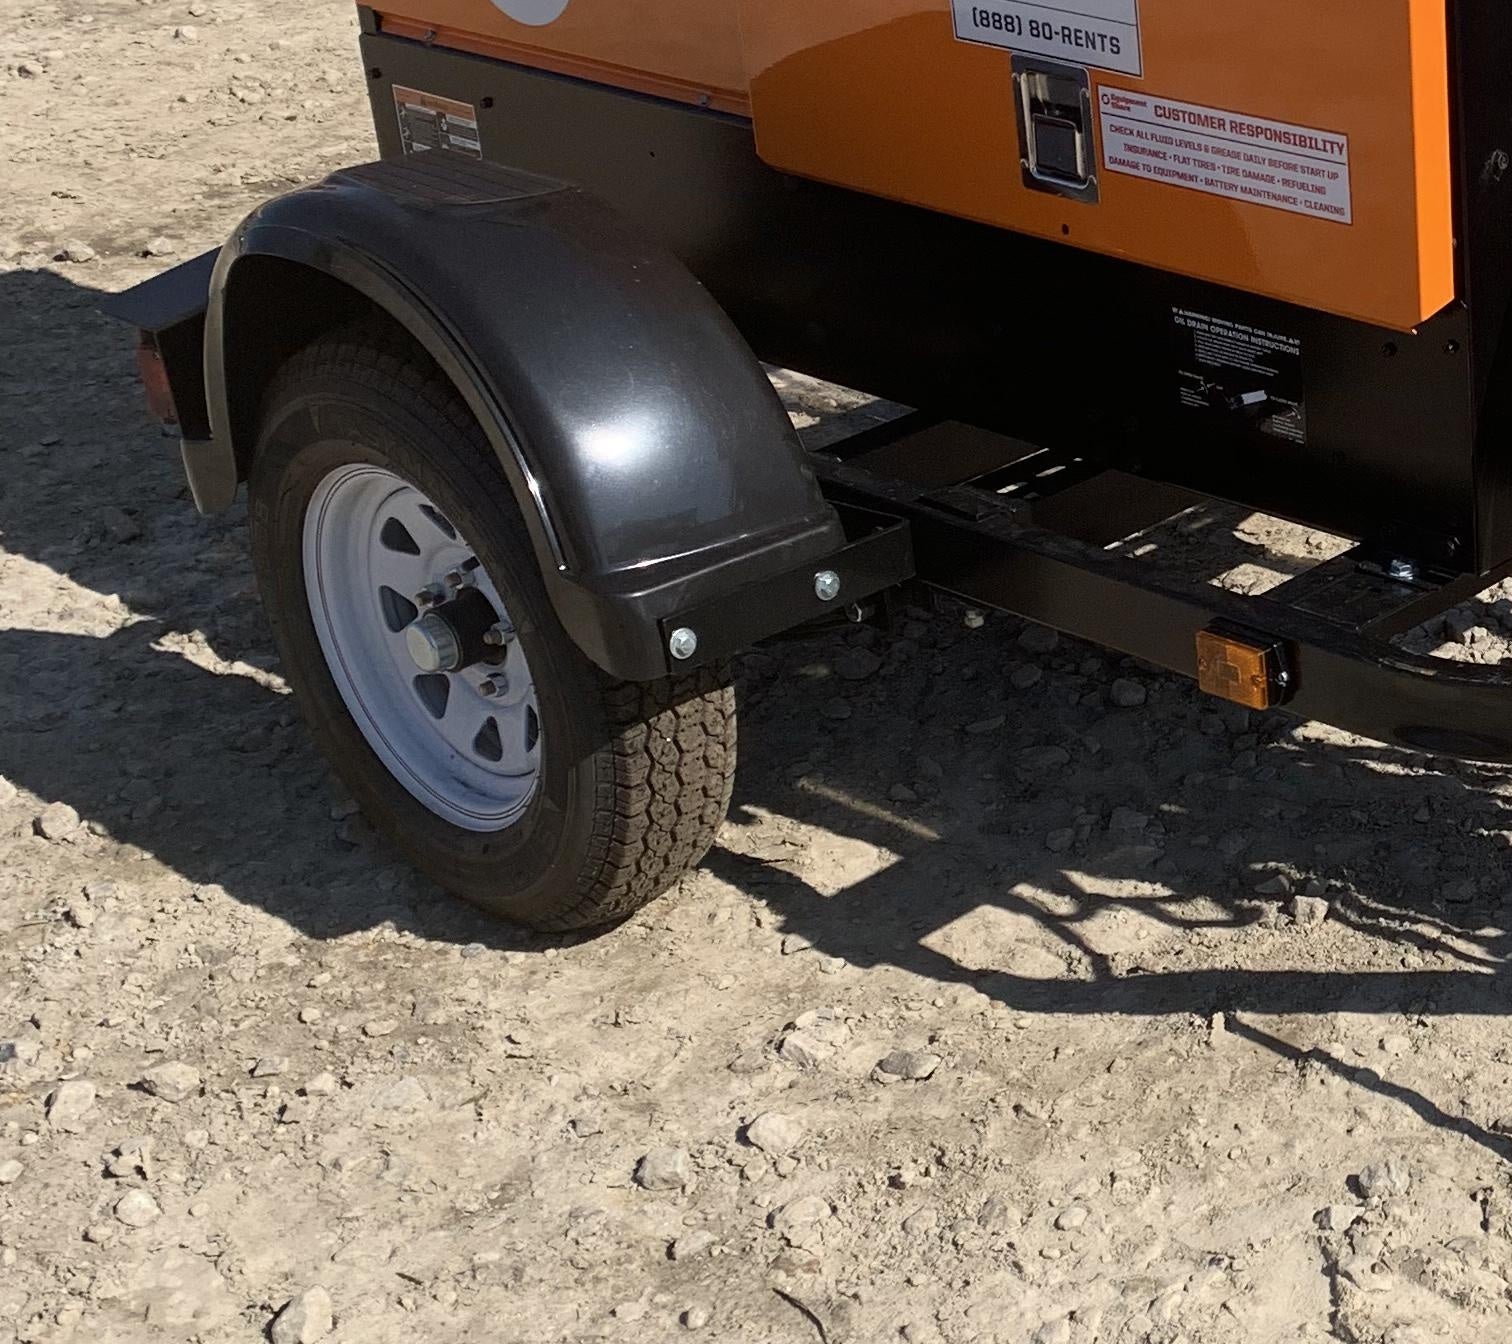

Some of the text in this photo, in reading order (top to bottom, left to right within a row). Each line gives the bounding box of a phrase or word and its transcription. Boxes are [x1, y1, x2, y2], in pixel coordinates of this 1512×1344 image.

[972, 7, 1121, 54] (888) 80-RENTS
[1109, 124, 1135, 137] CHECK
[1136, 129, 1150, 141] ALL
[1175, 138, 1202, 153] LEVELS
[1211, 146, 1242, 161] GREASE
[1243, 153, 1266, 167] DAILY
[1268, 158, 1299, 173] BEFORE
[1300, 165, 1326, 179] START
[1327, 171, 1339, 181] UP
[1154, 105, 1345, 155] CUSTOMER RESPONSIBILITY
[1108, 156, 1345, 217] DAMAGE TO EQUIPMENT BATTERY MAINTENANCE CLEANING
[1123, 143, 1326, 196] INSURANCE FLAT TIRES TIRE DAMAGE REFUELING
[1186, 319, 1209, 332] DRAIN
[1209, 325, 1249, 342] OPERATION
[1250, 336, 1300, 356] INSTRUCTIONS
